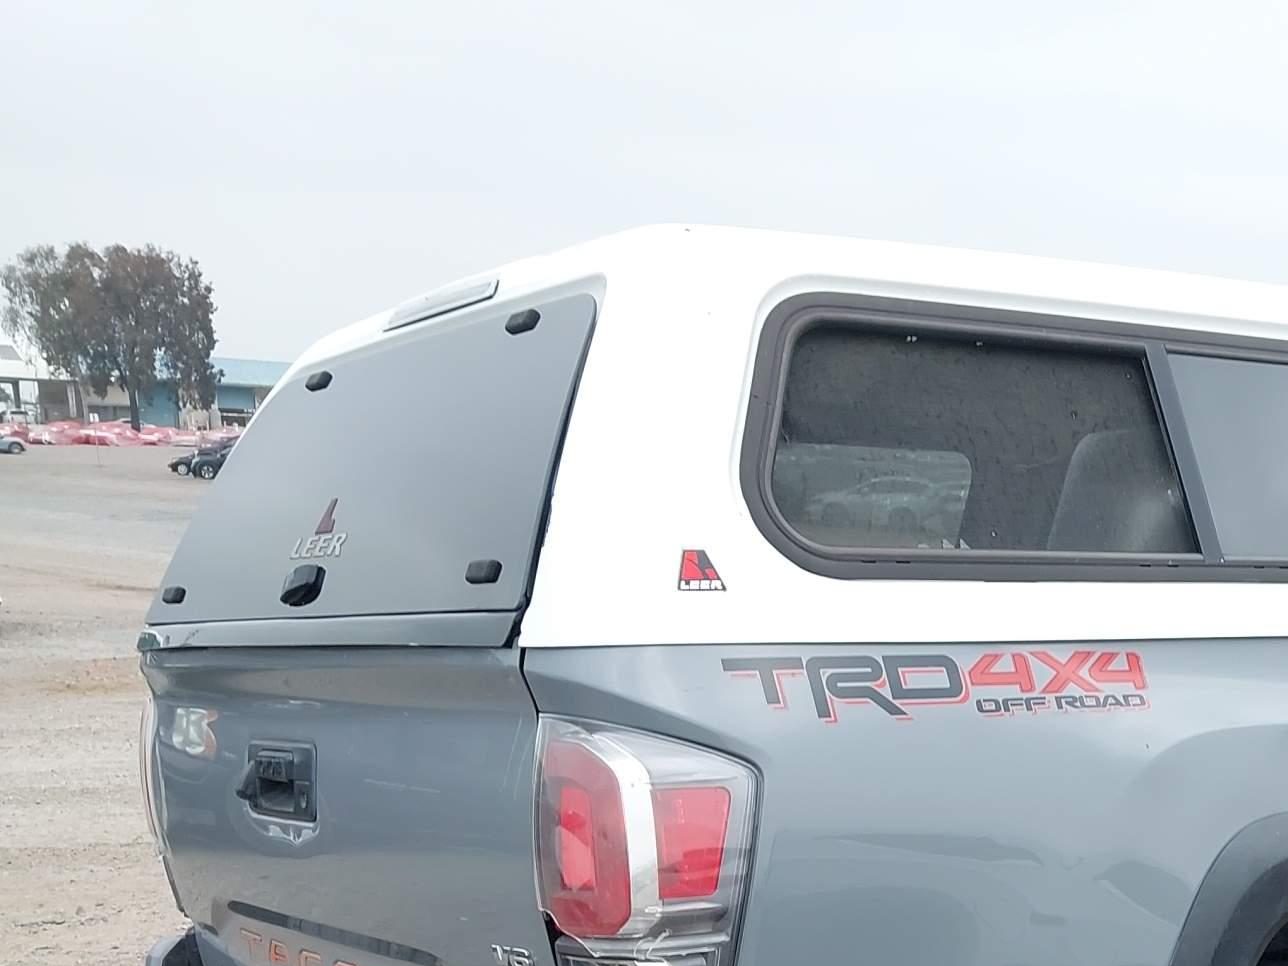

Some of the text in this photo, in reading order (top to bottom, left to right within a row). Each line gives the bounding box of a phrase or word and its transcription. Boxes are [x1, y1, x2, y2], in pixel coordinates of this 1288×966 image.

[289, 532, 348, 560] LEER
[680, 579, 724, 590] LEER
[721, 654, 969, 722] TRD
[976, 693, 1150, 716] OFF ROAD
